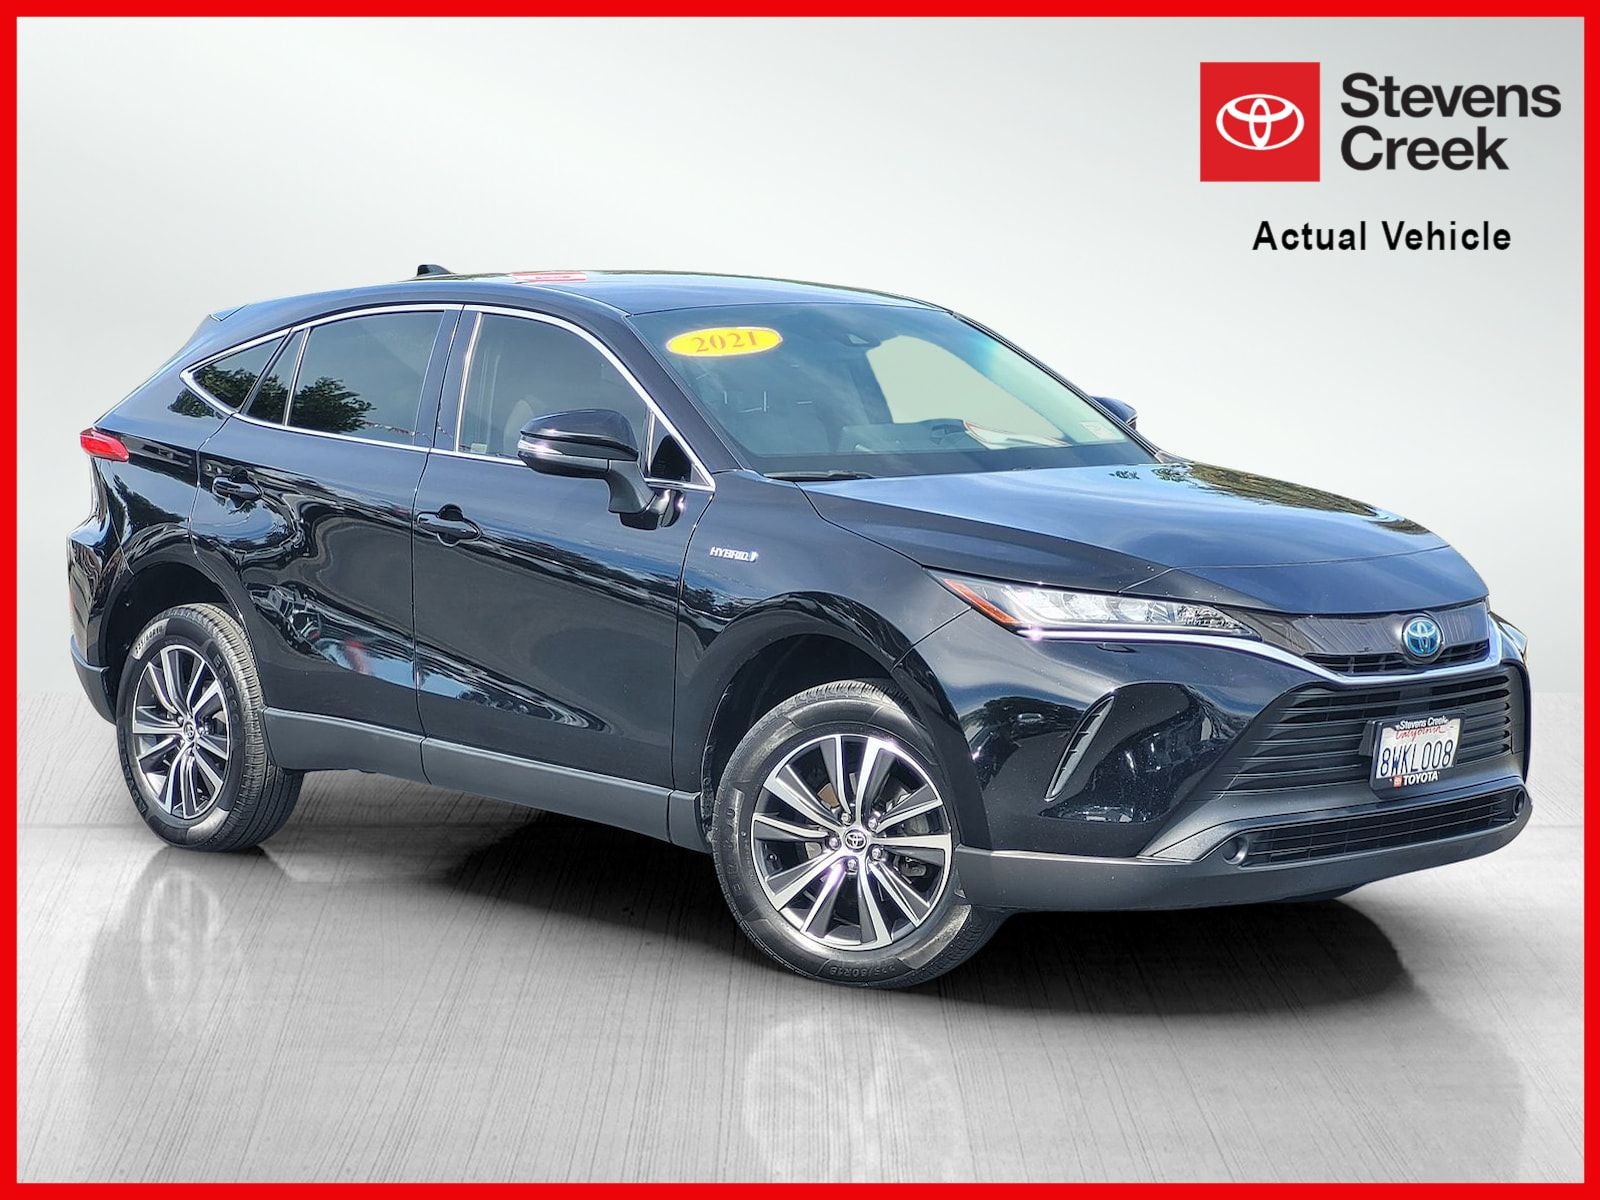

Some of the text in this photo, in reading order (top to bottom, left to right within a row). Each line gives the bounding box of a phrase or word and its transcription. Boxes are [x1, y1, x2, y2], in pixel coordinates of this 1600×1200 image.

[690, 331, 759, 353] 2021
[709, 546, 749, 562] HYBRID
[1400, 715, 1448, 730] Stevens Creek
[1380, 739, 1454, 777] 8WKL008
[1403, 770, 1439, 786] TOYOTA
